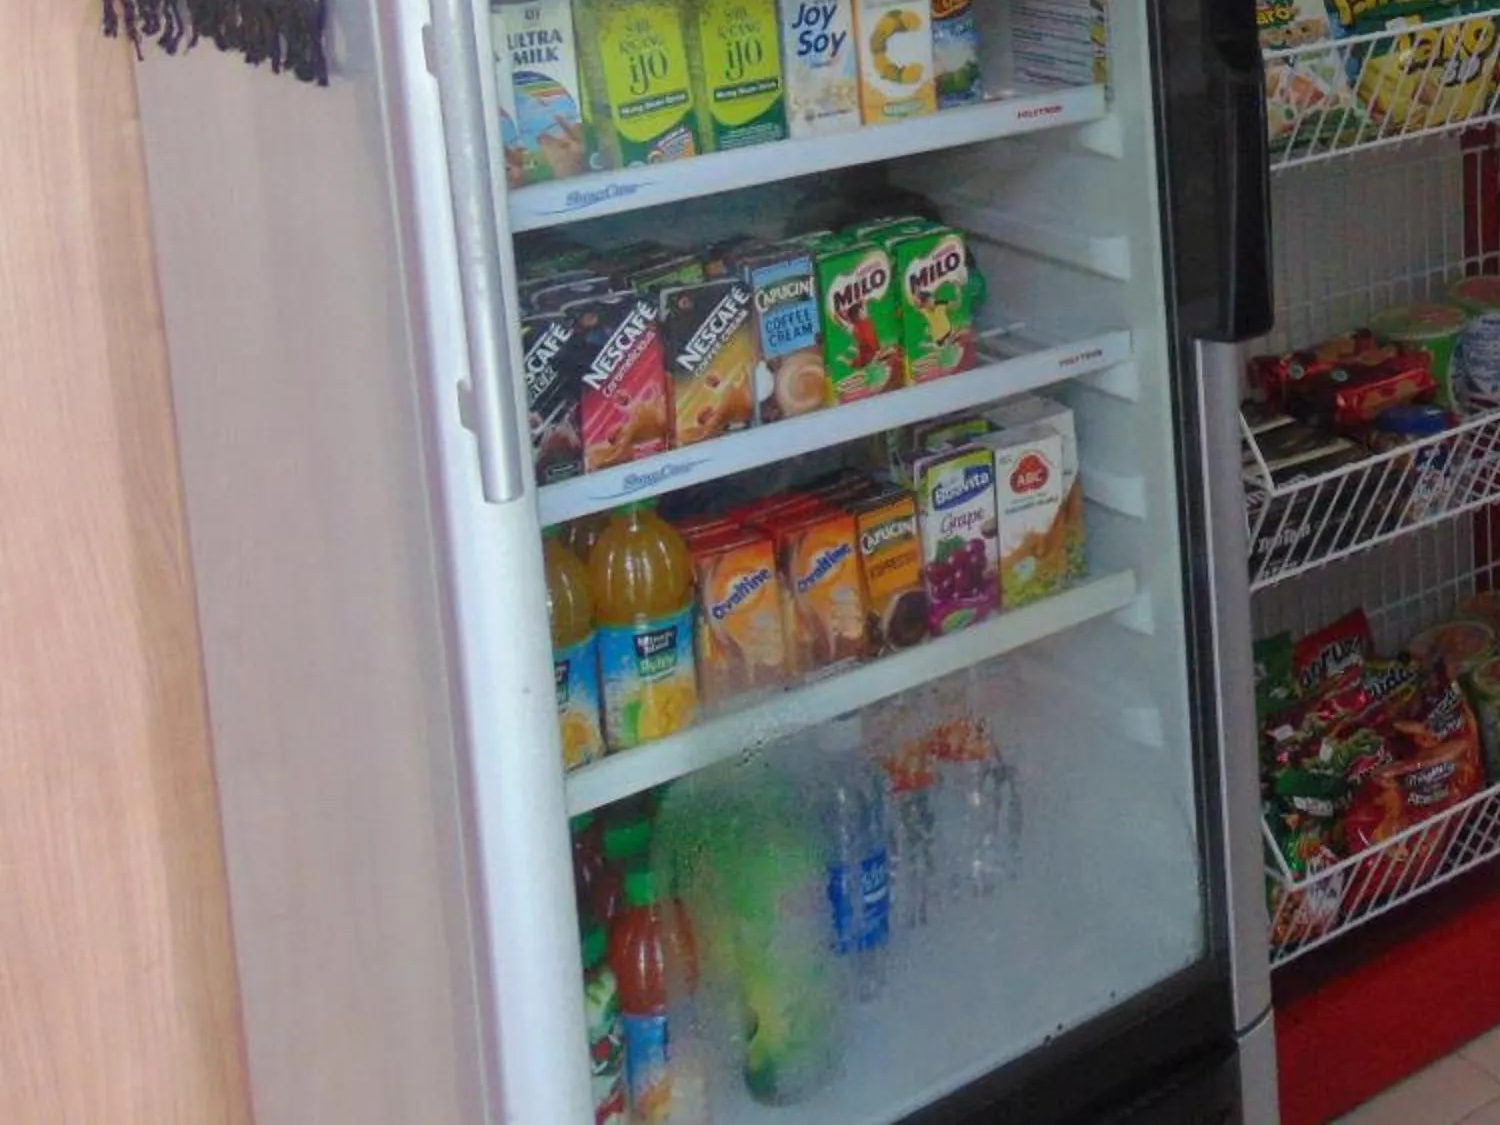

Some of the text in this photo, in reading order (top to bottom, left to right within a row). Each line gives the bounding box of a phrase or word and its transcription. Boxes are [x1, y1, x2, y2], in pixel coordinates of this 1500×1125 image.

[792, 2, 837, 29] Joy
[507, 28, 563, 51] ULTRA
[797, 30, 847, 58] Soy
[513, 46, 560, 66] MILK
[910, 252, 961, 293] MILO
[833, 268, 887, 313] MILO
[766, 306, 810, 332] COFFEE
[769, 323, 814, 347] CREAM
